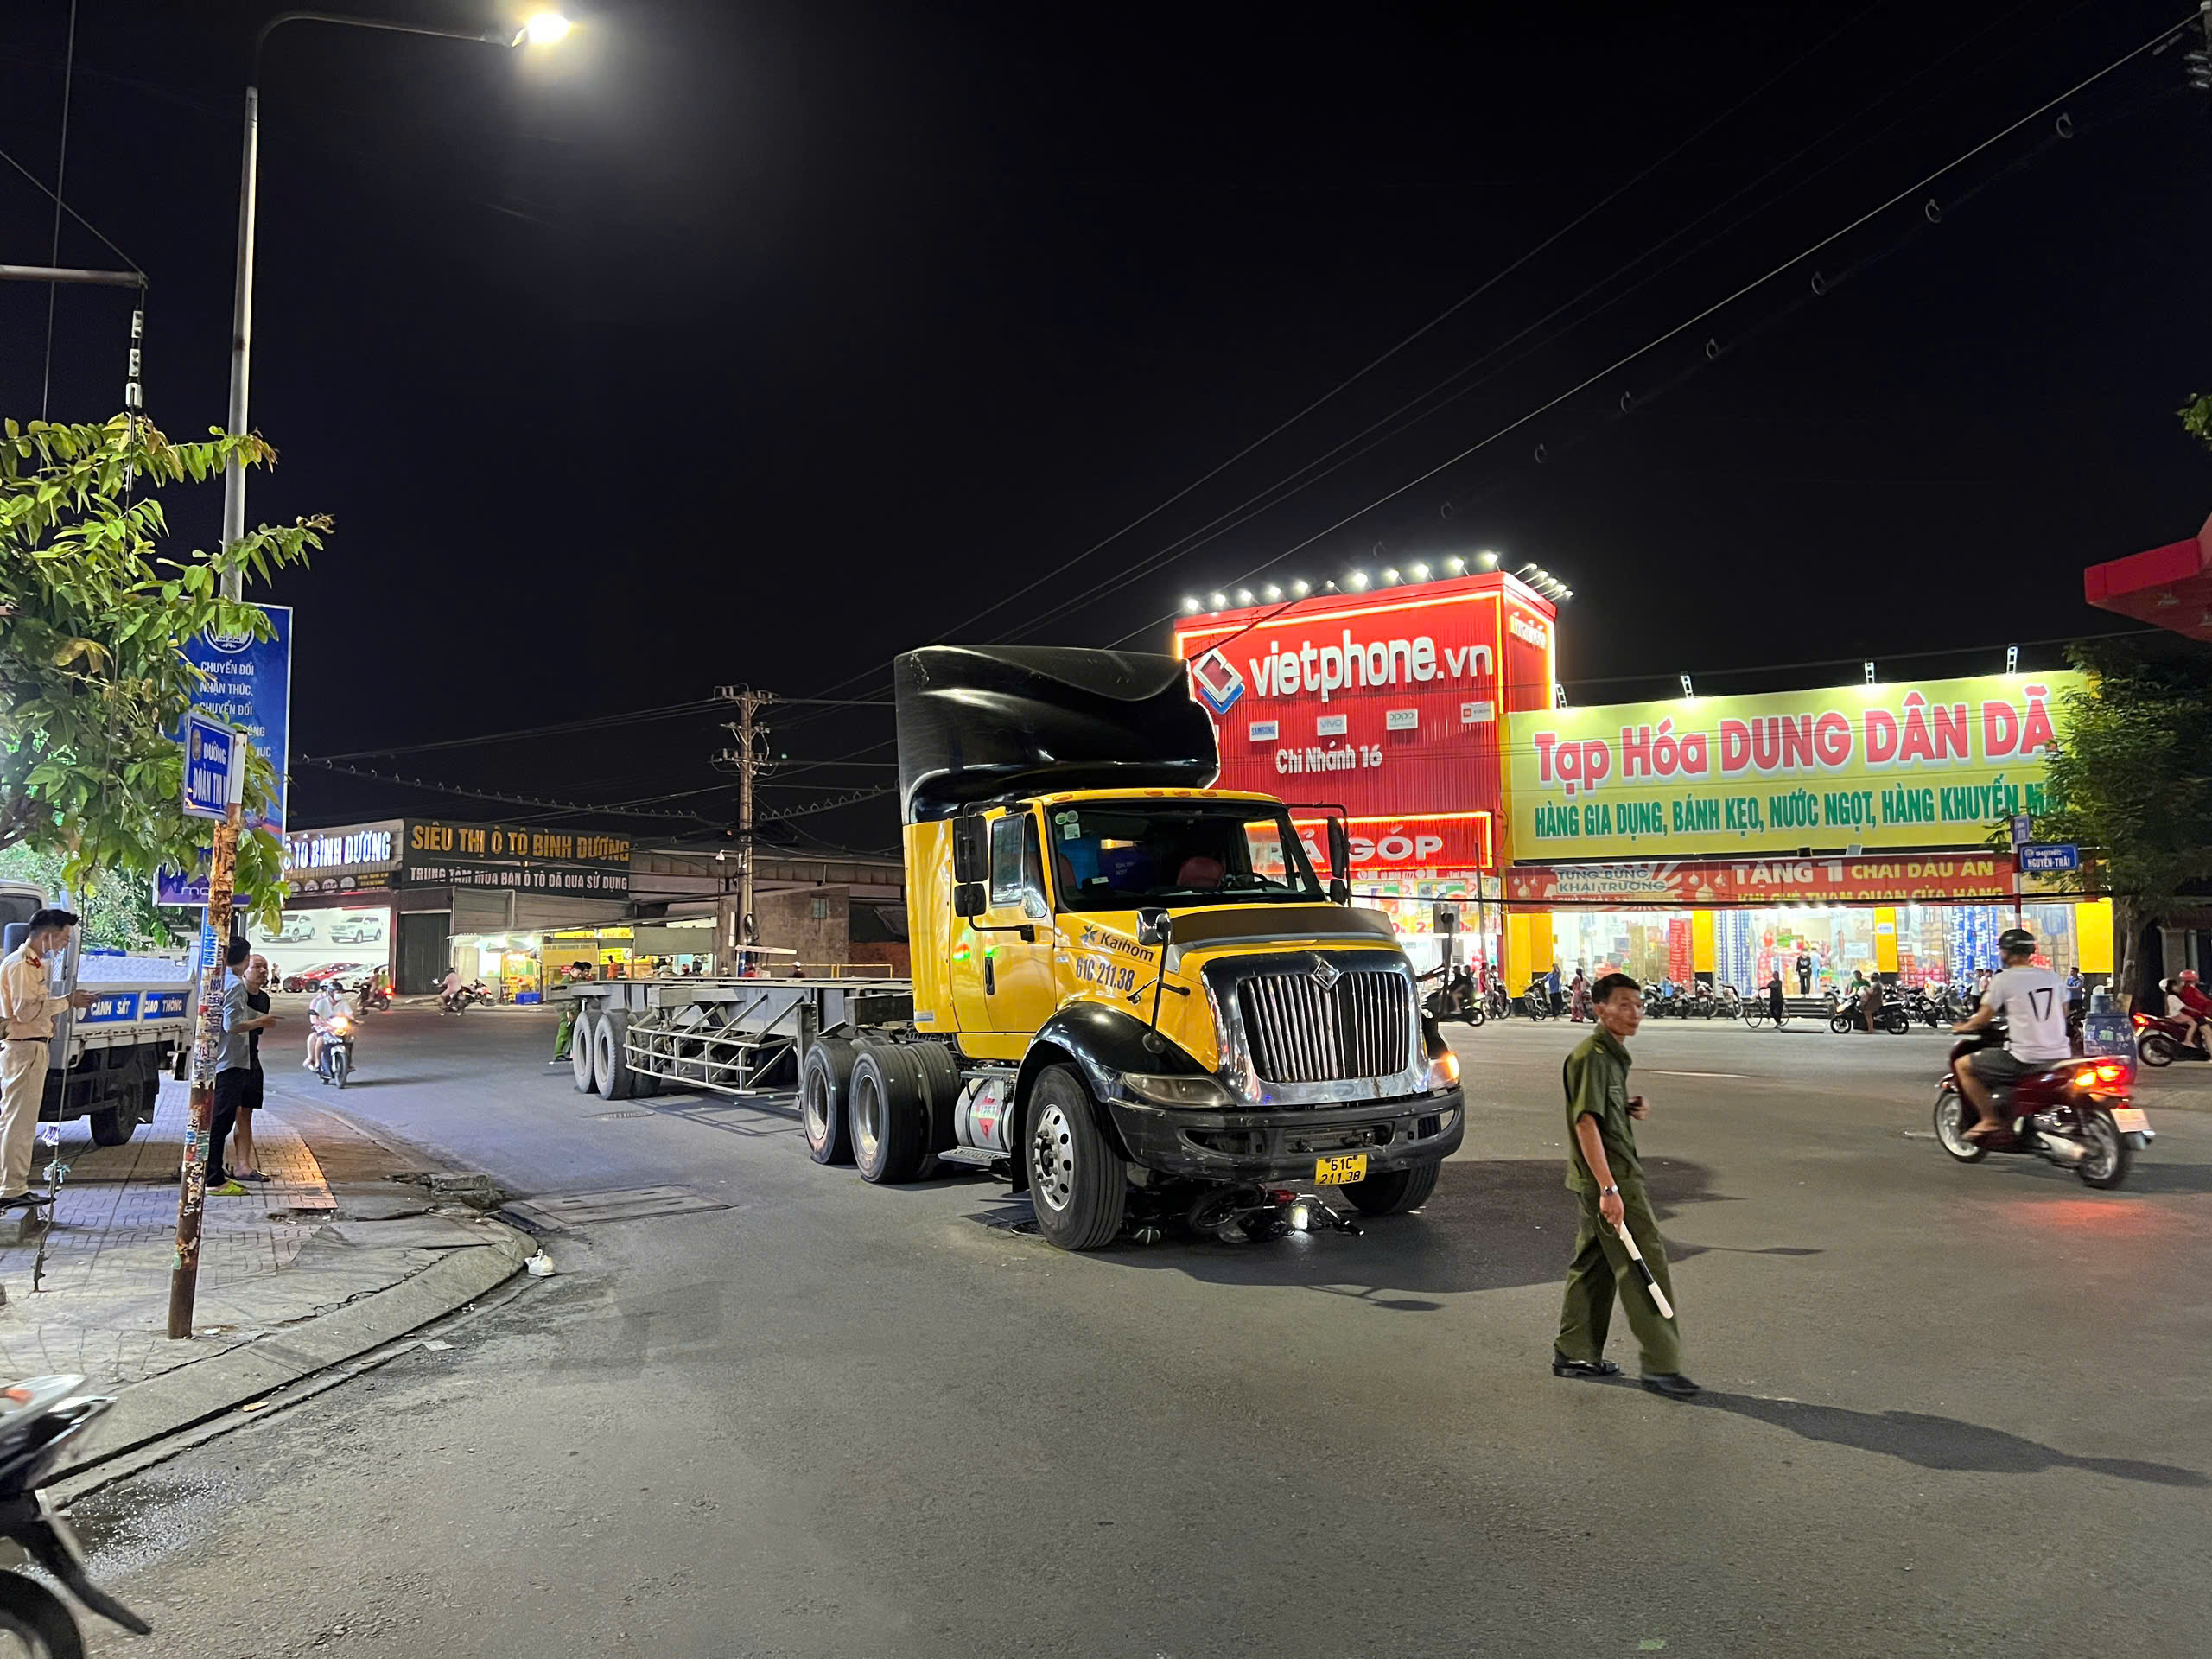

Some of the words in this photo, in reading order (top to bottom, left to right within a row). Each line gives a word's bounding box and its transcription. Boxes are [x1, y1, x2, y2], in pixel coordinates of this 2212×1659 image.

[200, 659, 238, 675] CHUYỂN
[238, 661, 254, 676] ĐỔI
[1249, 629, 1493, 702] vietphone.vn
[200, 681, 226, 696] NHẬN
[199, 700, 236, 715] CHUYỂN
[237, 703, 253, 716] ĐỔI
[1251, 726, 1275, 736] SAMSUNG
[1320, 719, 1343, 728] vivo
[203, 740, 227, 764] ĐƯỜNG
[1535, 733, 1610, 796] Tạp
[1621, 719, 1707, 777] Hóa
[1720, 712, 1852, 772] DUNG
[1865, 691, 1969, 764] DÂN
[1983, 685, 2056, 757] DÃ
[1275, 748, 1302, 774] Chi
[1306, 741, 1356, 772] Nhánh
[1360, 744, 1383, 768] 16
[193, 762, 212, 802] ĐOÀN
[1535, 800, 1580, 837] HÀNG
[1584, 804, 1612, 836] GIA
[1617, 801, 1668, 841] DỤNG,
[1672, 793, 1720, 832] BÁNH
[1725, 797, 1764, 836] KẸO,
[1769, 788, 1819, 828] NƯỚC
[1824, 791, 1877, 832] NGỌT,
[1881, 782, 1935, 823] HÀNG
[1940, 773, 2019, 821] KHUYẾN
[294, 832, 309, 869] TÔ
[311, 833, 343, 868] BÌNH
[344, 830, 391, 865] DƯƠNG
[411, 821, 454, 851] SIÊU
[457, 828, 485, 858] THỊ
[491, 825, 503, 854] Ô
[507, 827, 529, 855] TÔ
[532, 829, 572, 858] BÌNH
[576, 836, 630, 861] DƯƠNG
[1348, 825, 1443, 861] GÓP
[410, 867, 446, 882] TRUNG
[448, 866, 472, 884] TÂM
[524, 870, 531, 887] Ô
[533, 870, 546, 887] TÔ
[549, 872, 562, 887] ĐÃ
[564, 874, 584, 889] QUA
[587, 871, 600, 889] SỬ
[602, 876, 628, 893] DỤNG
[1732, 859, 1814, 888] TẶNG
[1818, 860, 1843, 882] 1
[1851, 863, 1900, 880] CHAI
[1907, 857, 1955, 879] DẦU
[1960, 857, 1994, 877] ĂN
[1559, 882, 1596, 892] KHAI
[1952, 886, 2005, 899] HÀNG
[1100, 932, 1154, 963] Kaihom
[1076, 957, 1095, 982] 61C
[1096, 961, 1135, 992] 211.38
[91, 1001, 112, 1016] CẢNH
[116, 997, 131, 1015] SÁT
[162, 997, 183, 1013] THÔNG
[2028, 987, 2054, 1021] 17
[1319, 1171, 1361, 1185] 211.38
[1331, 1158, 1353, 1172] 61C
